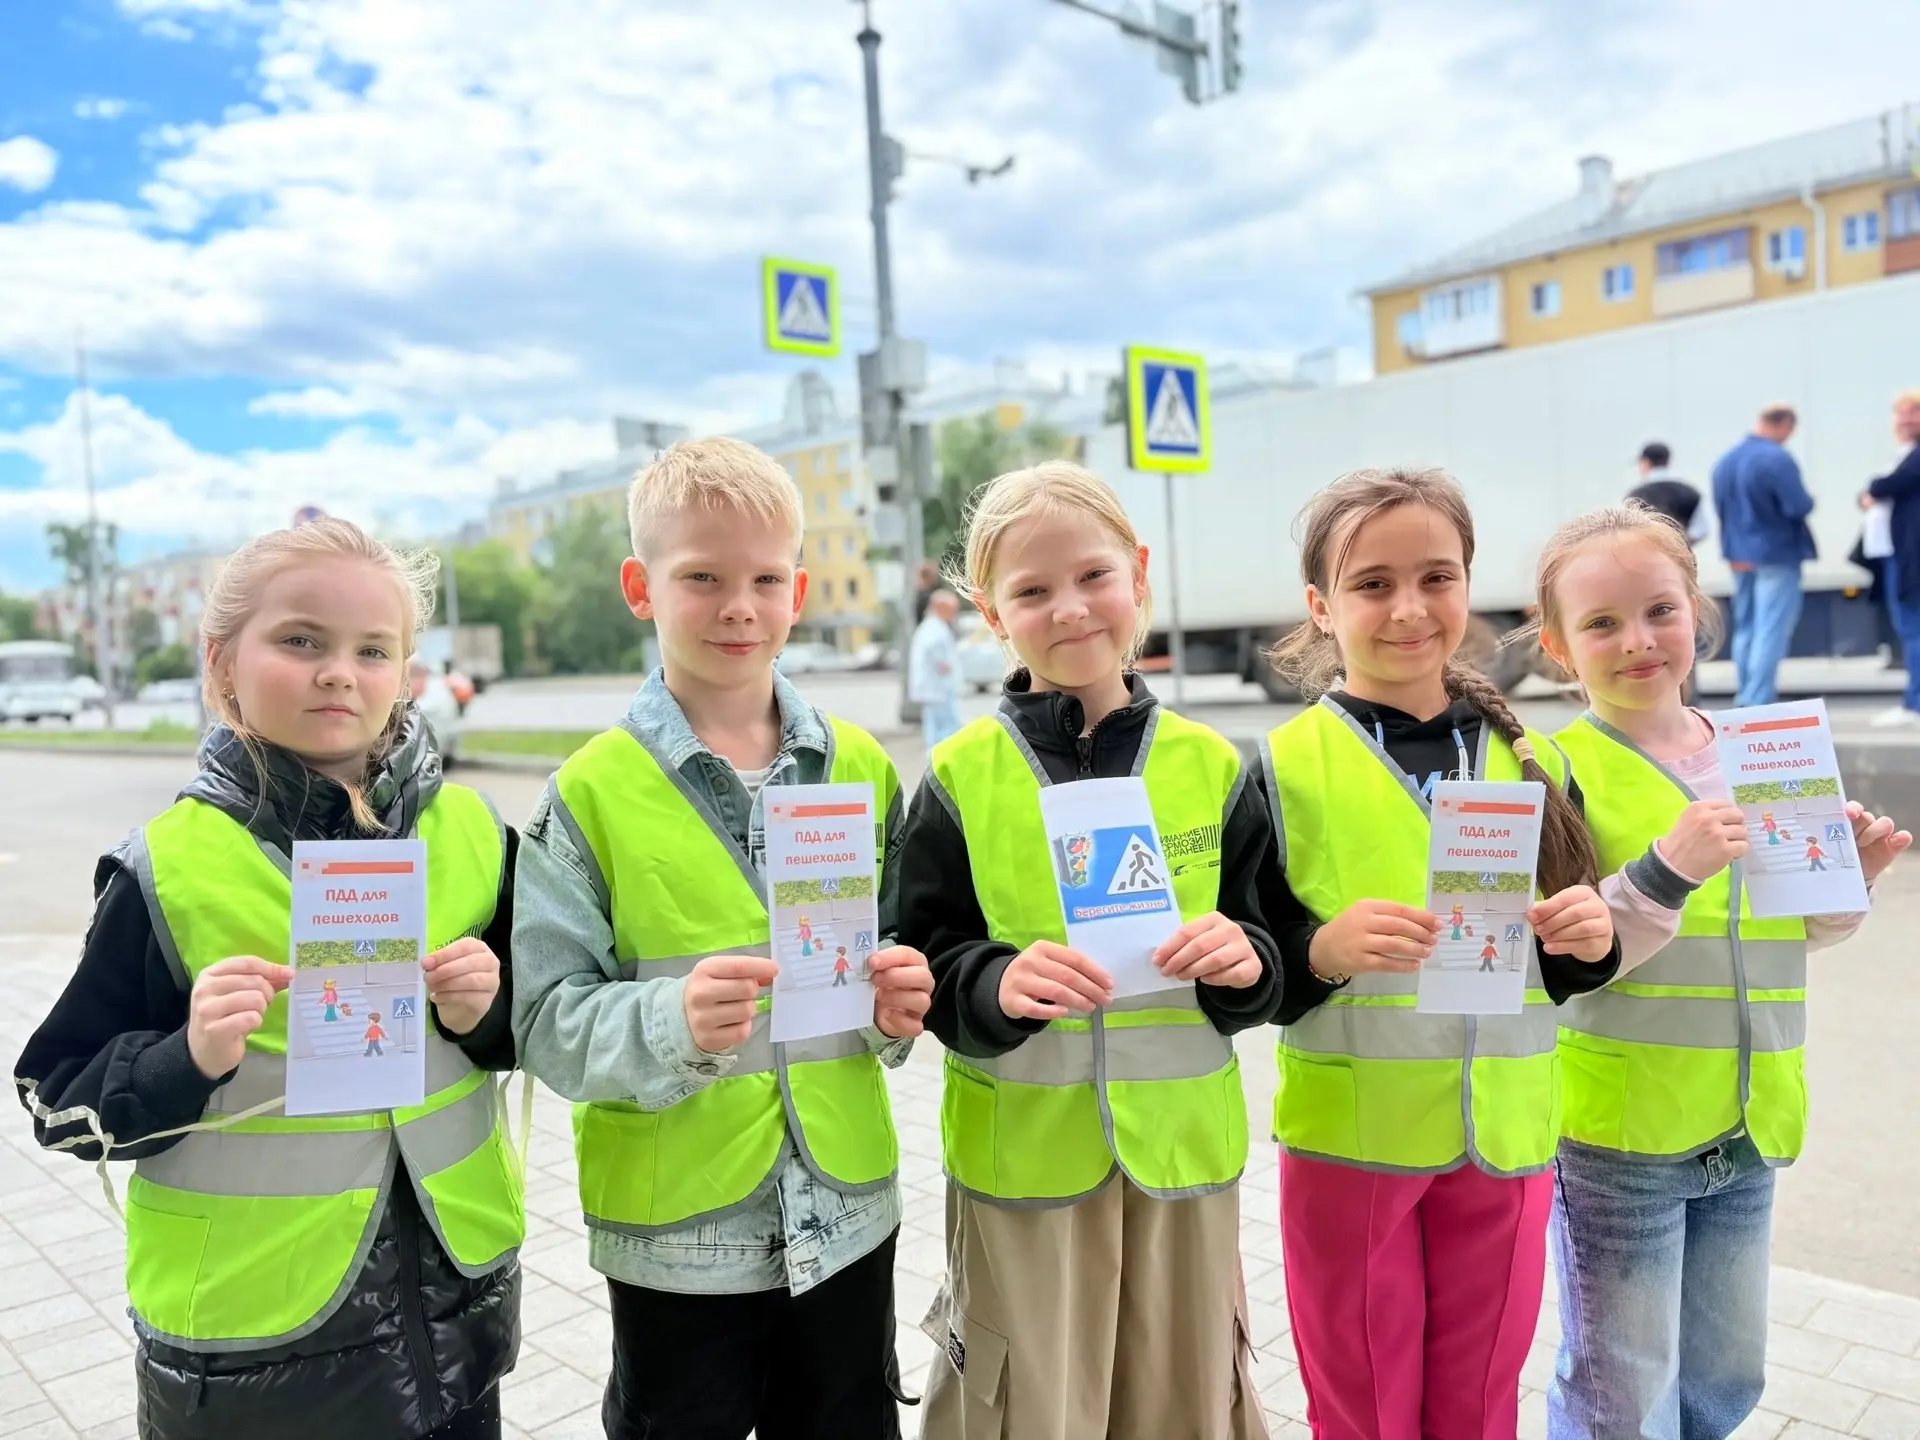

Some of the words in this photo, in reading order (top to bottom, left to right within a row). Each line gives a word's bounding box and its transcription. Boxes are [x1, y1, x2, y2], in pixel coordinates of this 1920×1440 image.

[1747, 740, 1776, 754] ПДД
[1778, 740, 1801, 752] для
[1741, 757, 1815, 772] пешеходов
[795, 831, 822, 844] ПДД
[824, 830, 846, 843] для
[1459, 825, 1486, 838] ПДД
[1488, 828, 1511, 839] для
[785, 852, 857, 866] пешеходов
[1447, 846, 1518, 860] пешеходов
[325, 888, 358, 903] ПДД
[361, 889, 388, 902] для
[312, 912, 399, 925] пешеходов
